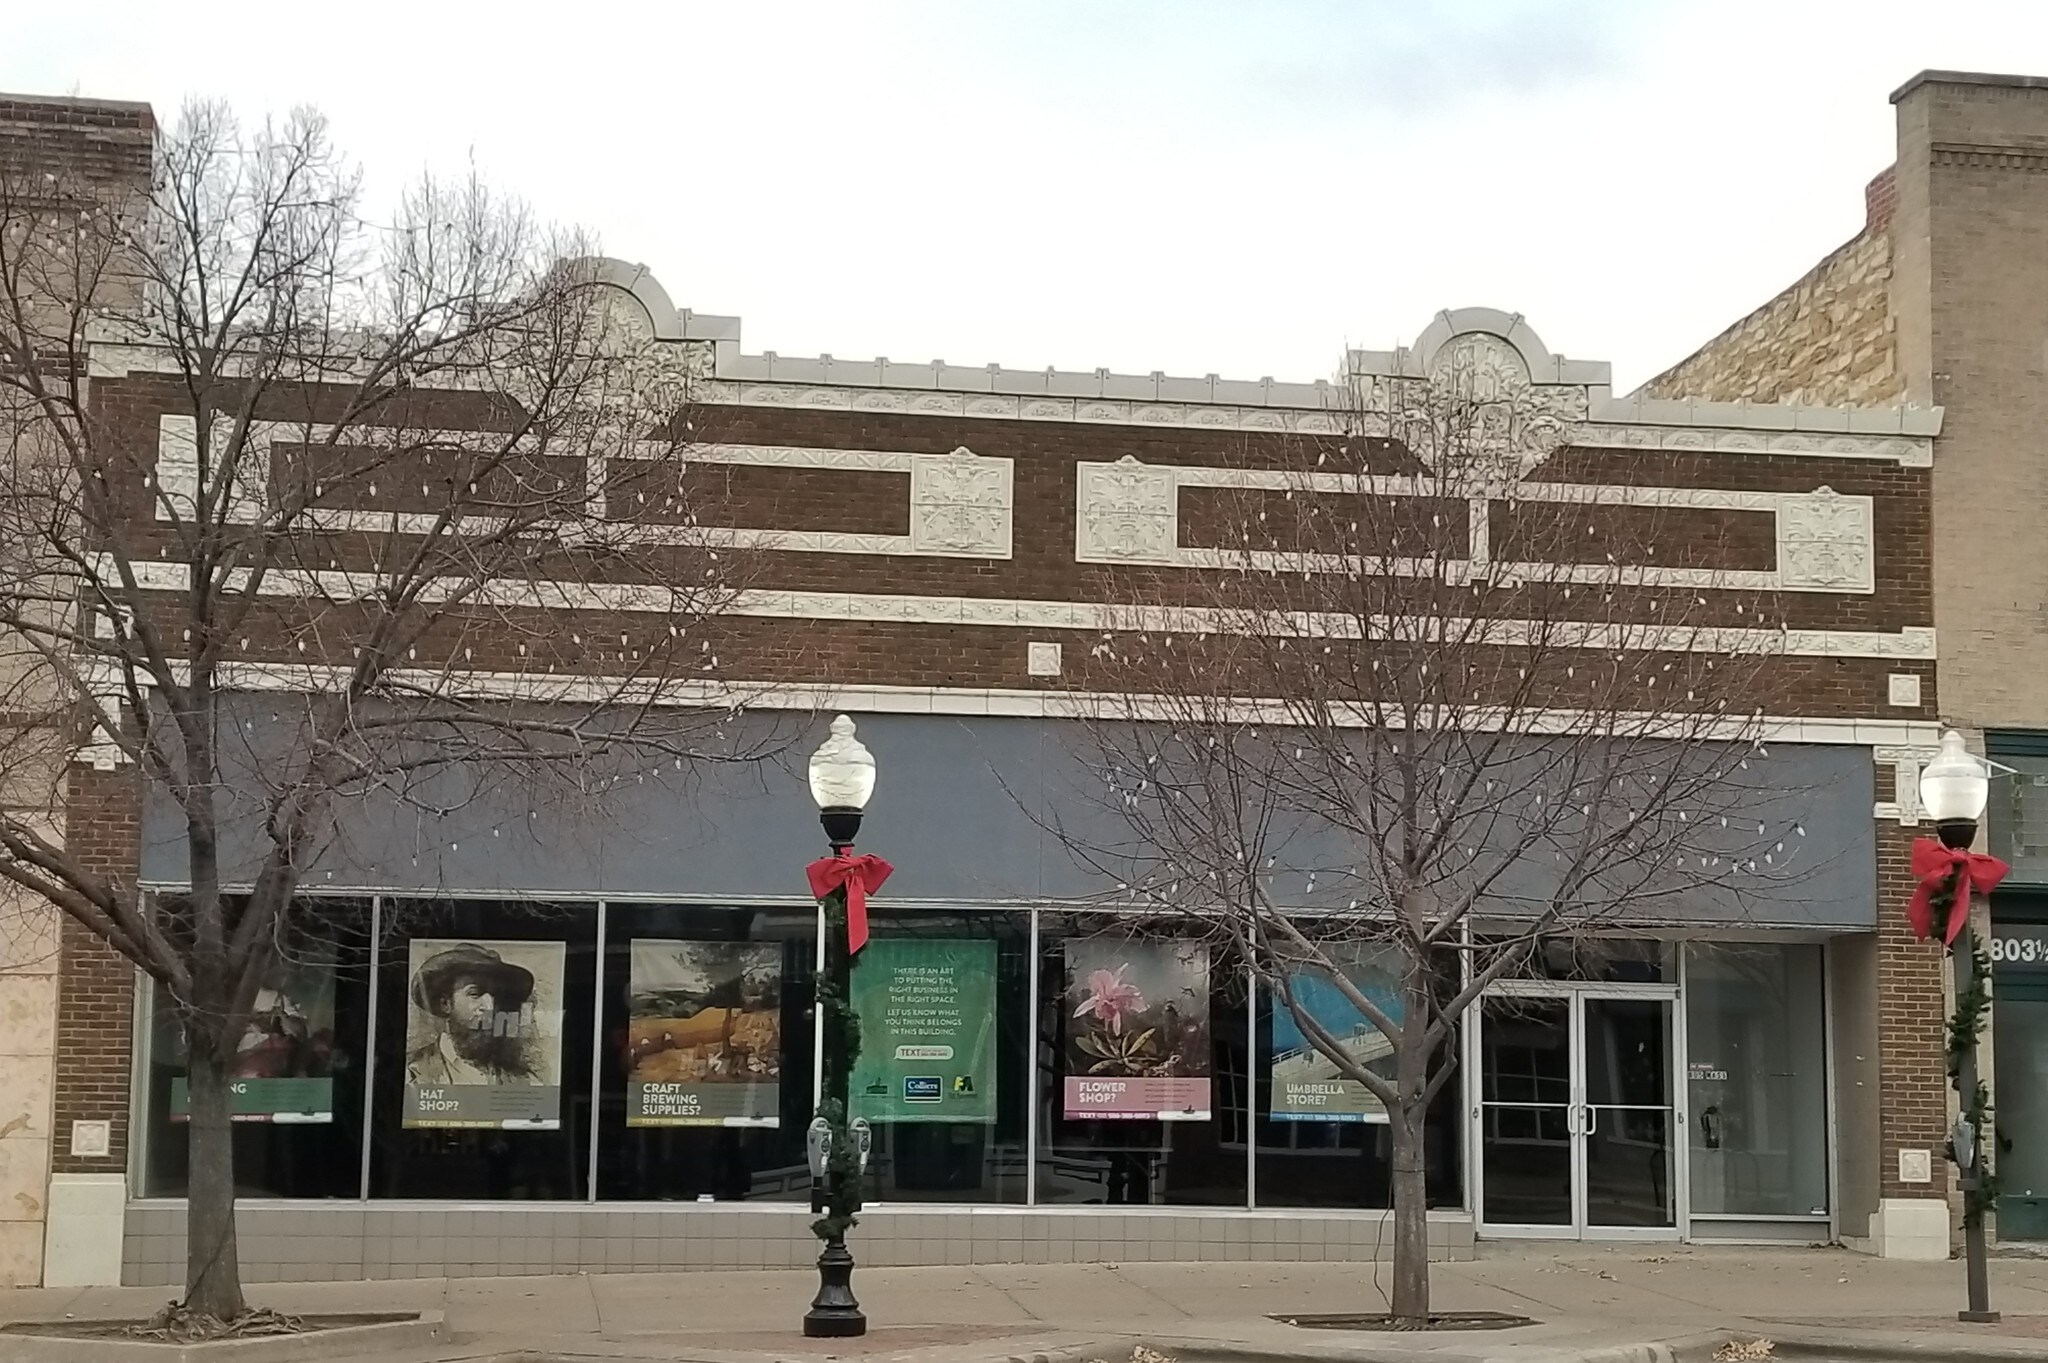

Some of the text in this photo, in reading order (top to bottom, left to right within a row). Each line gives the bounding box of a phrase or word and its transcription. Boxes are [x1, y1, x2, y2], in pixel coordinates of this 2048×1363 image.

[893, 967, 954, 975] THERE IS AN ART
[939, 977, 954, 985] THE
[913, 986, 948, 994] BUSINESS
[891, 995, 957, 1004] THE RIGHT SPACE.
[887, 1008, 901, 1016] LET
[901, 1008, 911, 1016] US
[912, 1008, 937, 1016] KNOW
[918, 1028, 957, 1036] BUILDING.
[900, 1048, 921, 1057] TEXT
[642, 1083, 682, 1094] CRAFT
[1078, 1082, 1127, 1093] FLOWER
[1286, 1083, 1345, 1095] UMBRELLA
[419, 1089, 445, 1100] HAT
[642, 1094, 698, 1105] BREWING
[1078, 1092, 1117, 1103] SHOP?
[1286, 1094, 1327, 1106] STORE?
[418, 1100, 460, 1111] SHOP?
[641, 1104, 701, 1115] SUPPLIES?
